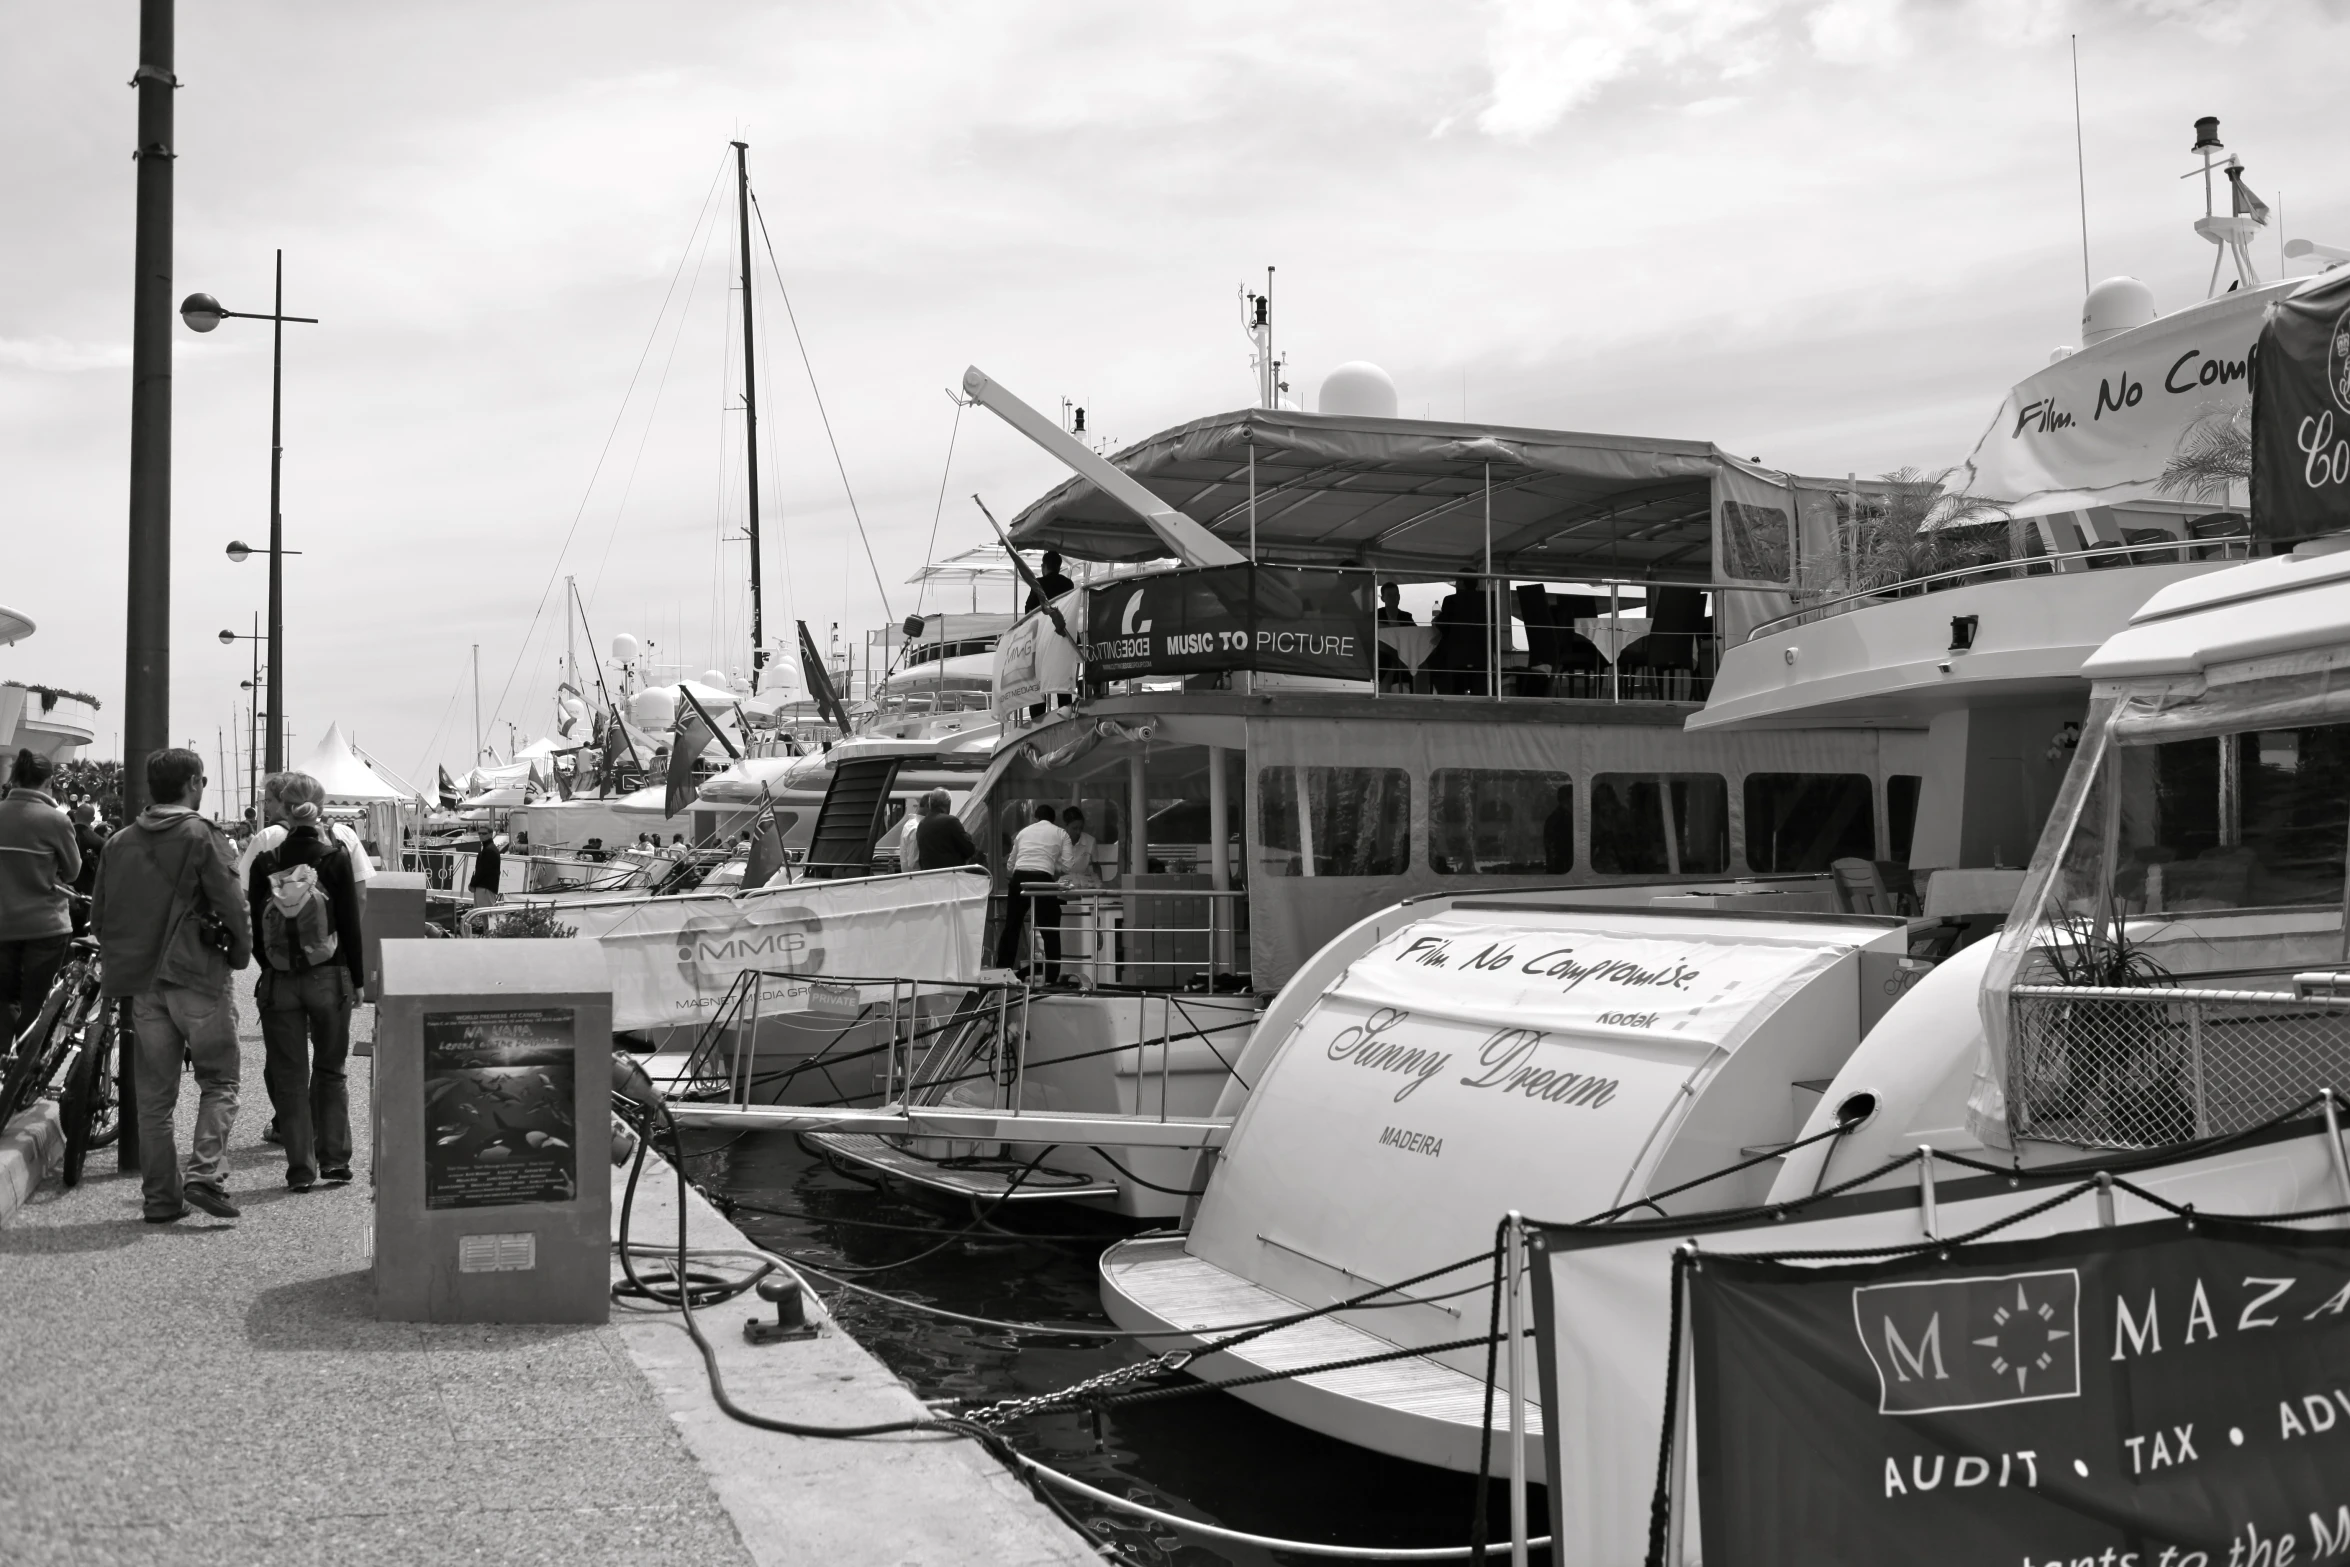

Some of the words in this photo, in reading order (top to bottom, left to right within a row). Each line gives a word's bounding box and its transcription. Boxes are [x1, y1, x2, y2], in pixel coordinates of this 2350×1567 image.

[2012, 397, 2076, 440] Film.
[2094, 370, 2143, 420] No
[1167, 631, 1214, 656] MUSIC
[1219, 630, 1248, 651] TO
[1256, 631, 1355, 657] PICTURE
[699, 931, 806, 961] MMG
[1396, 936, 1447, 969] Film.
[1459, 943, 1514, 972] No
[1521, 948, 1700, 994] Compromise.
[675, 995, 737, 1009] MAGNET
[812, 993, 857, 1007] PRIVATE
[1596, 1010, 1659, 1029] Kodak
[1327, 1006, 1453, 1103] Sunny
[1460, 1027, 1620, 1110] Dream
[1378, 1125, 1443, 1158] MADEIRA
[1883, 1310, 1949, 1383] M
[1884, 1450, 2038, 1498] AUDIT
[2124, 1423, 2199, 1475] TAX
[2229, 1522, 2296, 1567] the
